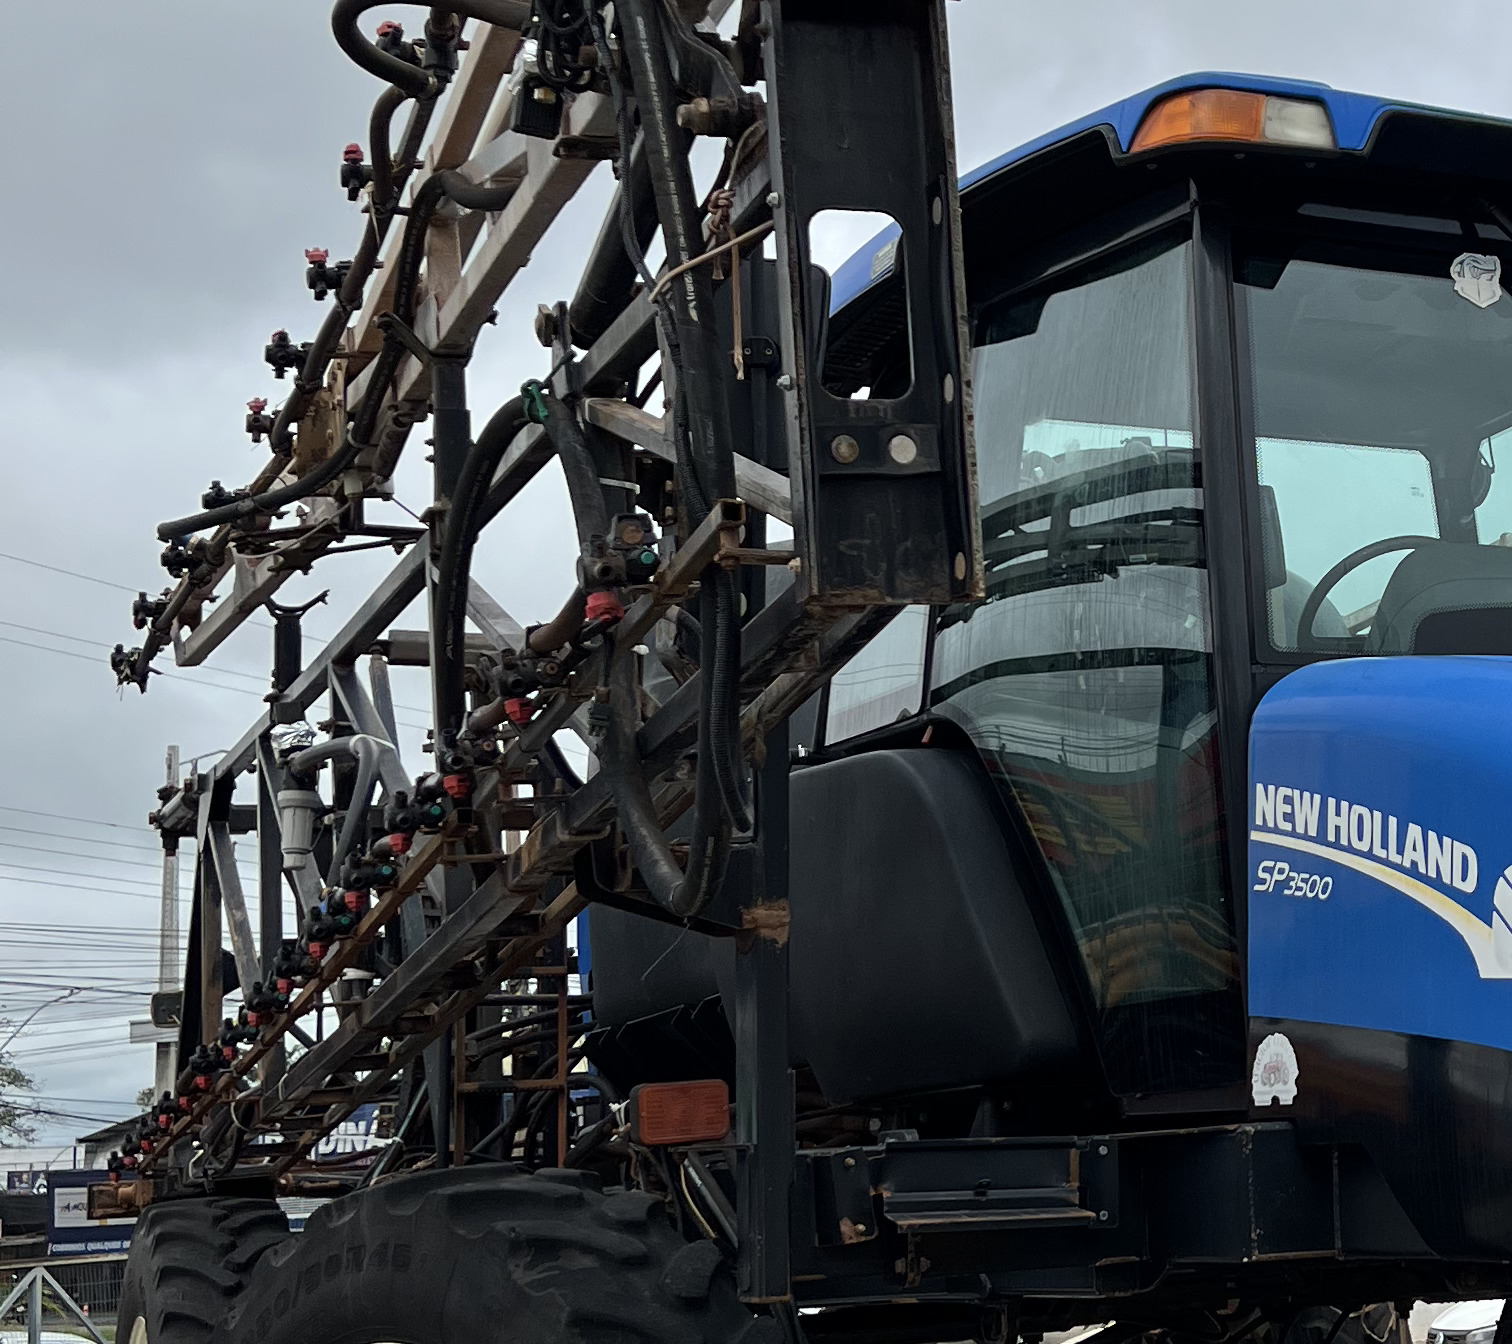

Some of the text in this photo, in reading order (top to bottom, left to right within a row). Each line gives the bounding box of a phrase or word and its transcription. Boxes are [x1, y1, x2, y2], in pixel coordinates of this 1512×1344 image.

[1256, 783, 1478, 894] NEW HOLLAND
[1253, 860, 1332, 899] SP3500
